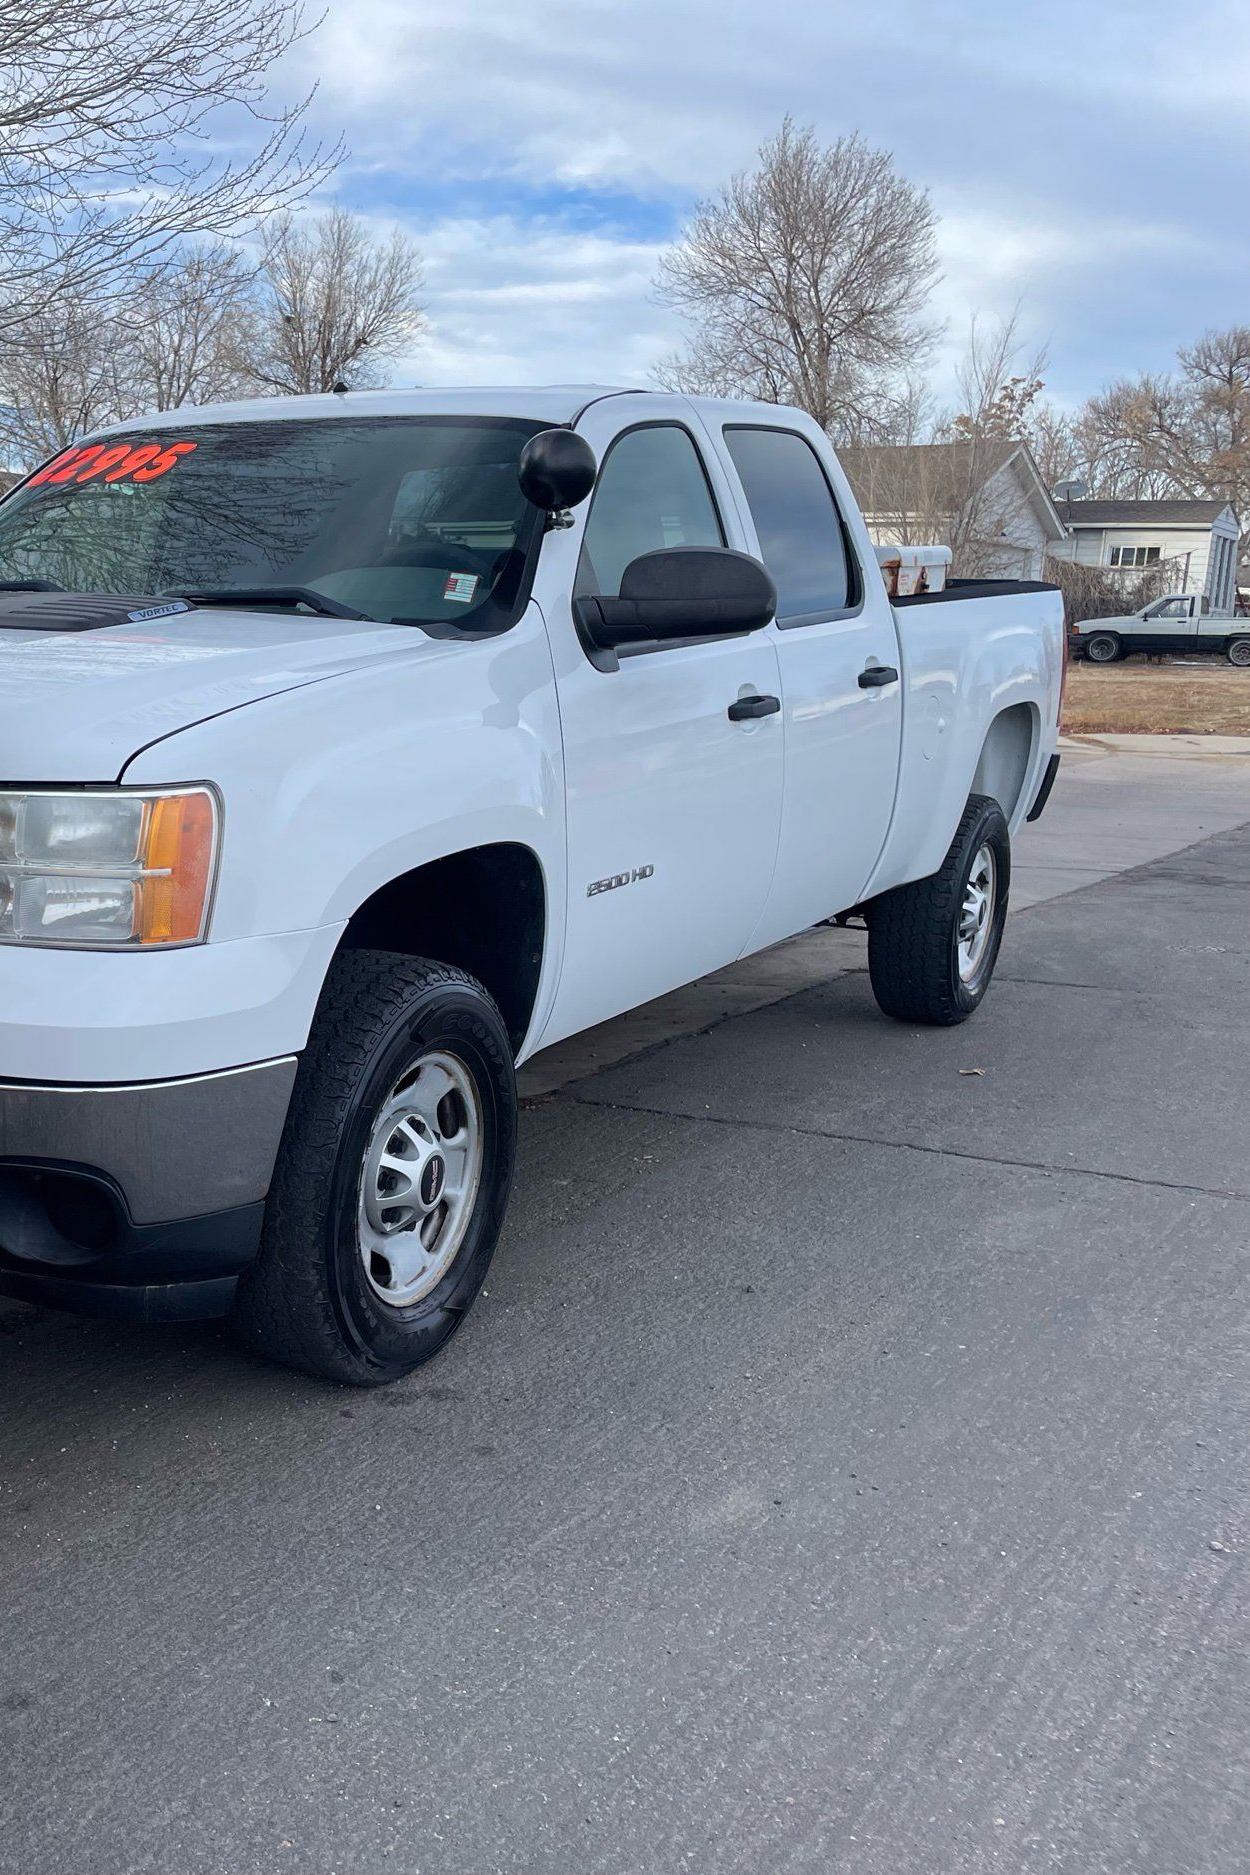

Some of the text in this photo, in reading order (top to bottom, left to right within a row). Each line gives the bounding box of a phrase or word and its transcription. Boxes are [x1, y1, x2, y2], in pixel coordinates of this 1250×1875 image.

[138, 604, 179, 618] VORTEC
[586, 864, 654, 897] 2500 HD
[429, 1159, 438, 1201] GMC
